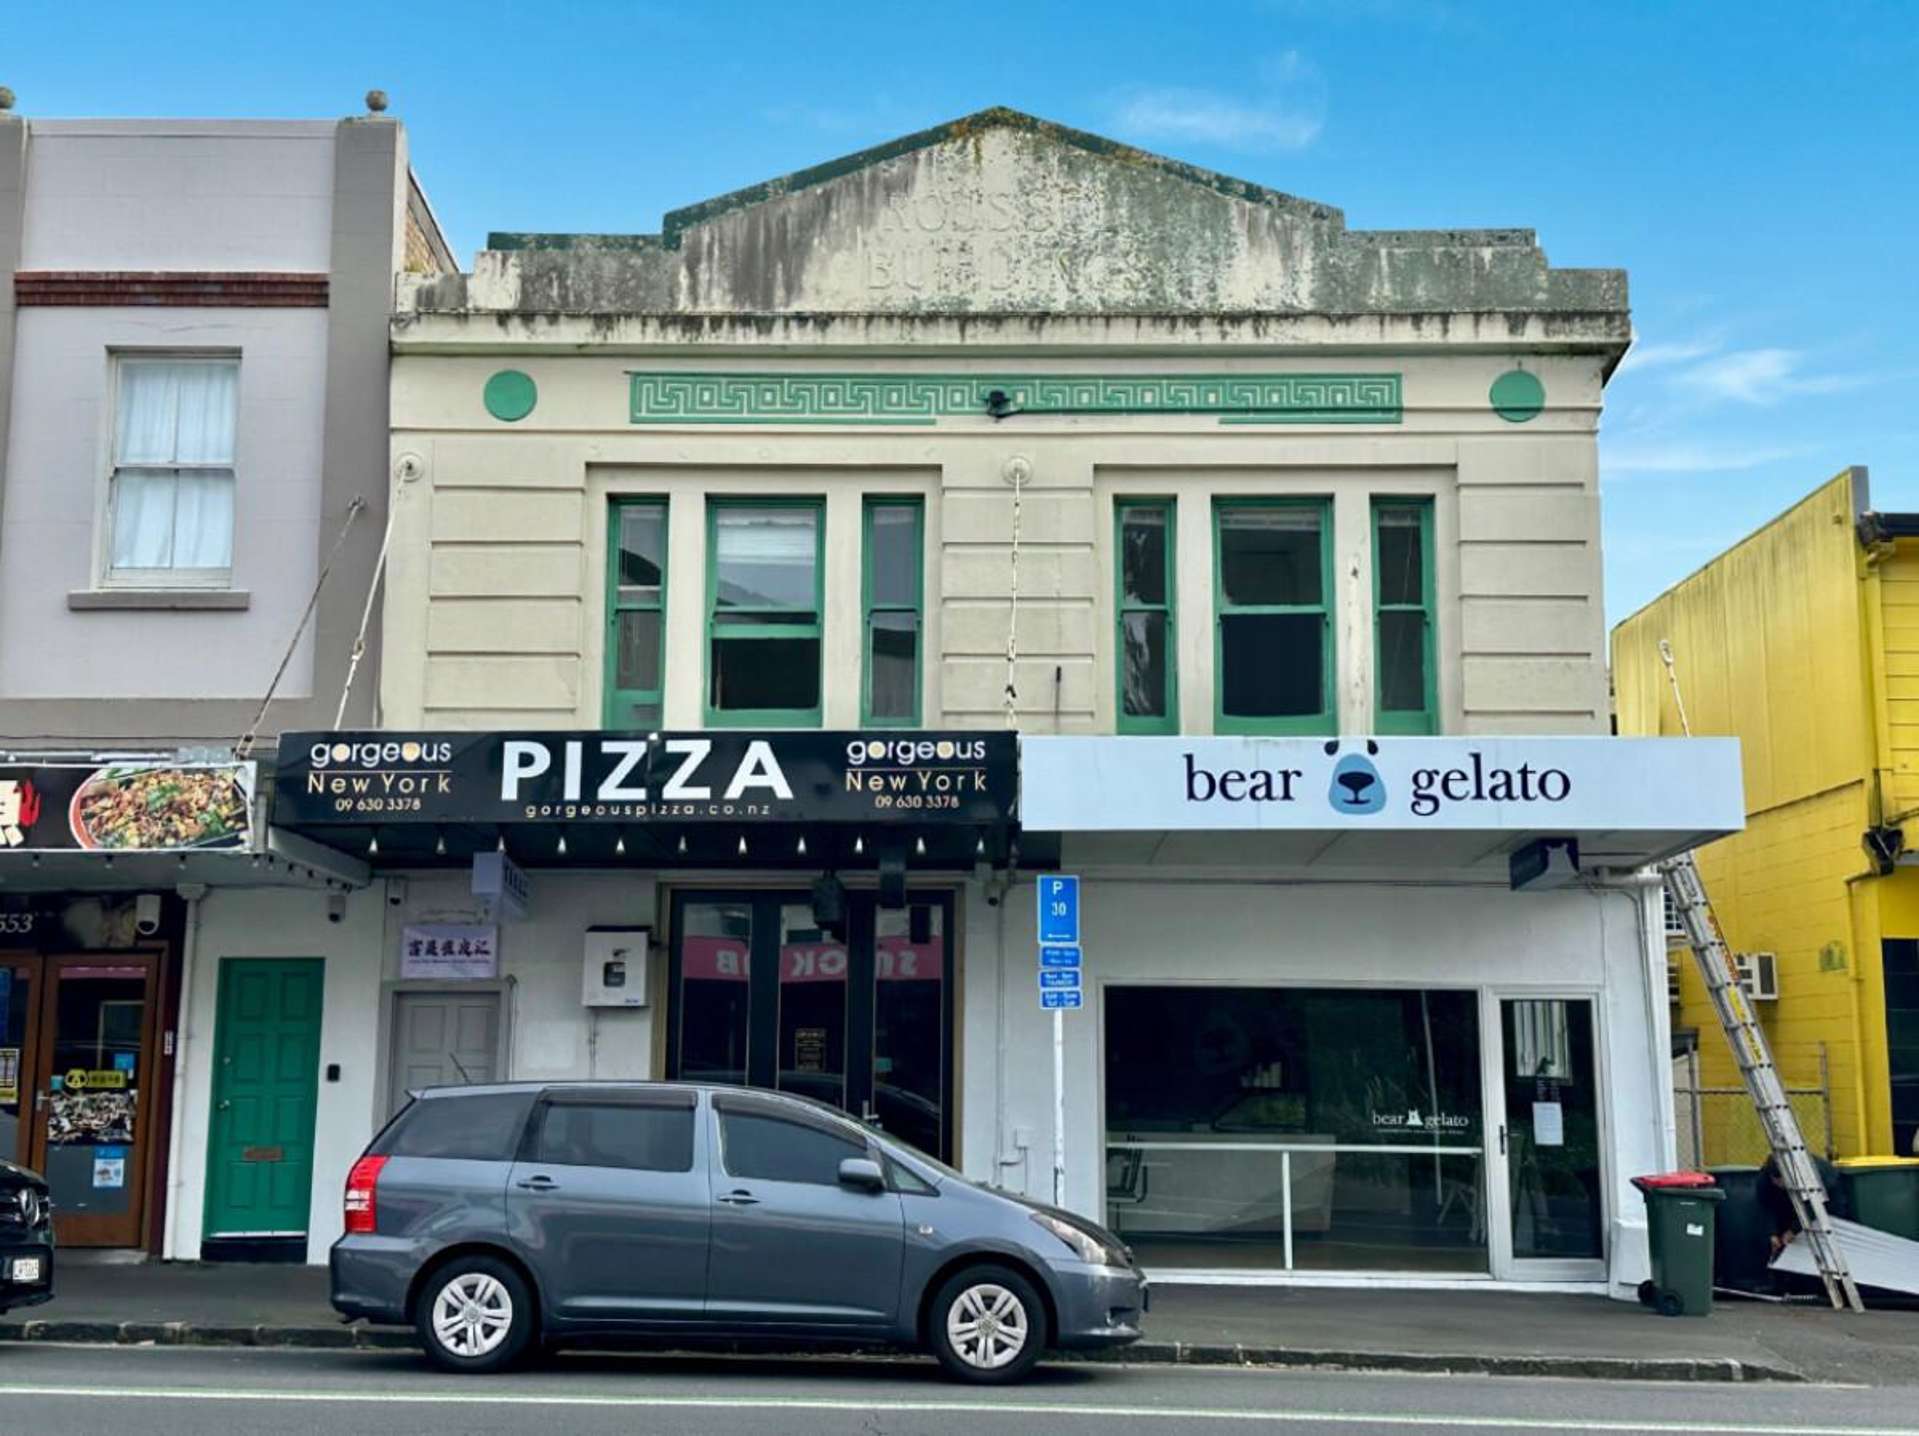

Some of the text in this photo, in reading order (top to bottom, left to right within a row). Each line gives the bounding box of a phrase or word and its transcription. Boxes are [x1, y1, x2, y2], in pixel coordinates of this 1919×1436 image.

[310, 742, 452, 768] gorgeous
[846, 740, 986, 765] gorgeous
[501, 740, 794, 800] PIZZA
[845, 770, 986, 791] New York
[307, 772, 450, 793] New York
[1183, 753, 1571, 816] bear gelato
[335, 798, 421, 811] 09 630 3378
[525, 803, 770, 818] gorgeouspizza.co.nz
[874, 795, 960, 808] 09 630 3378
[1052, 881, 1063, 895] P
[1372, 1109, 1469, 1129] bear gelato
